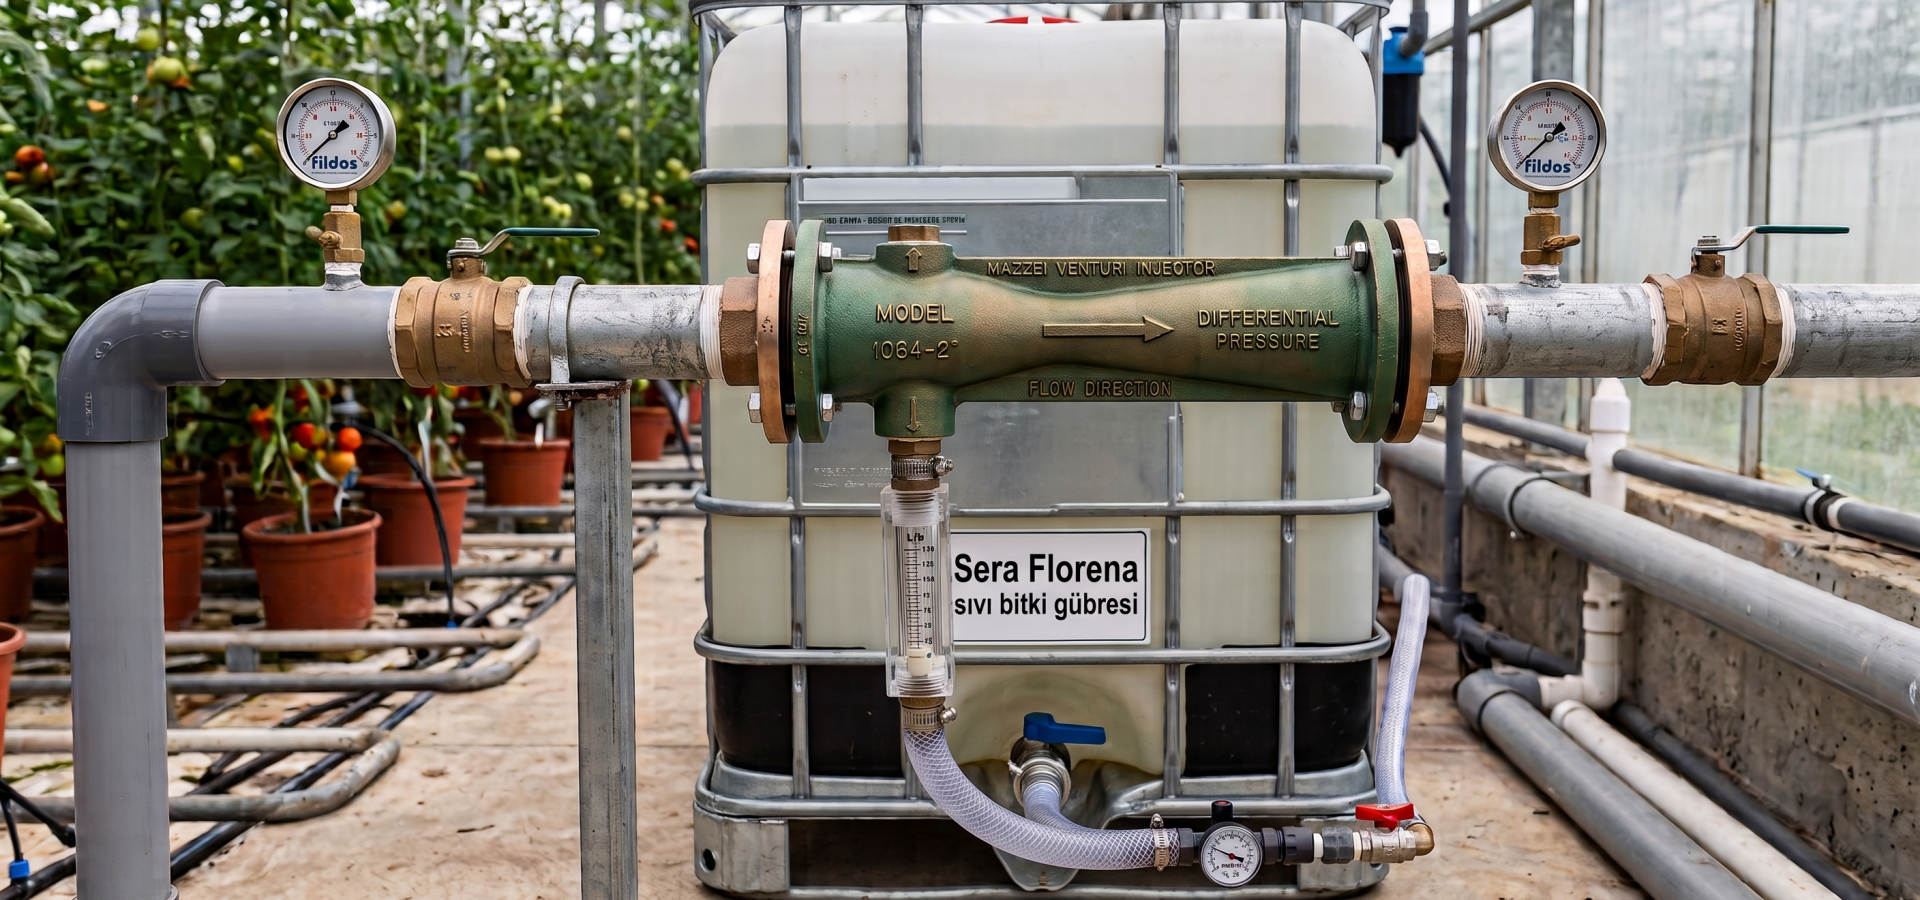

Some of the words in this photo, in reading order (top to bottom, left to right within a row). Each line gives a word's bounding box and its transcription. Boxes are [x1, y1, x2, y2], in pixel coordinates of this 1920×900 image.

[311, 155, 358, 170] fildos
[1525, 158, 1571, 173] fildos
[987, 261, 1048, 276] MAZZEI
[1058, 261, 1127, 277] VENTURI
[875, 303, 955, 323] MODEL
[1198, 309, 1340, 328] DIFFERENTIAL
[1216, 333, 1320, 350] PRESSURE
[1028, 380, 1076, 397] FLOW
[1084, 380, 1172, 397] DIRECTION
[954, 553, 1019, 583] Sera
[1029, 553, 1138, 583] Florena
[954, 598, 992, 616] sıvı
[1000, 592, 1047, 616] bitki
[1054, 592, 1138, 621] gübresi
